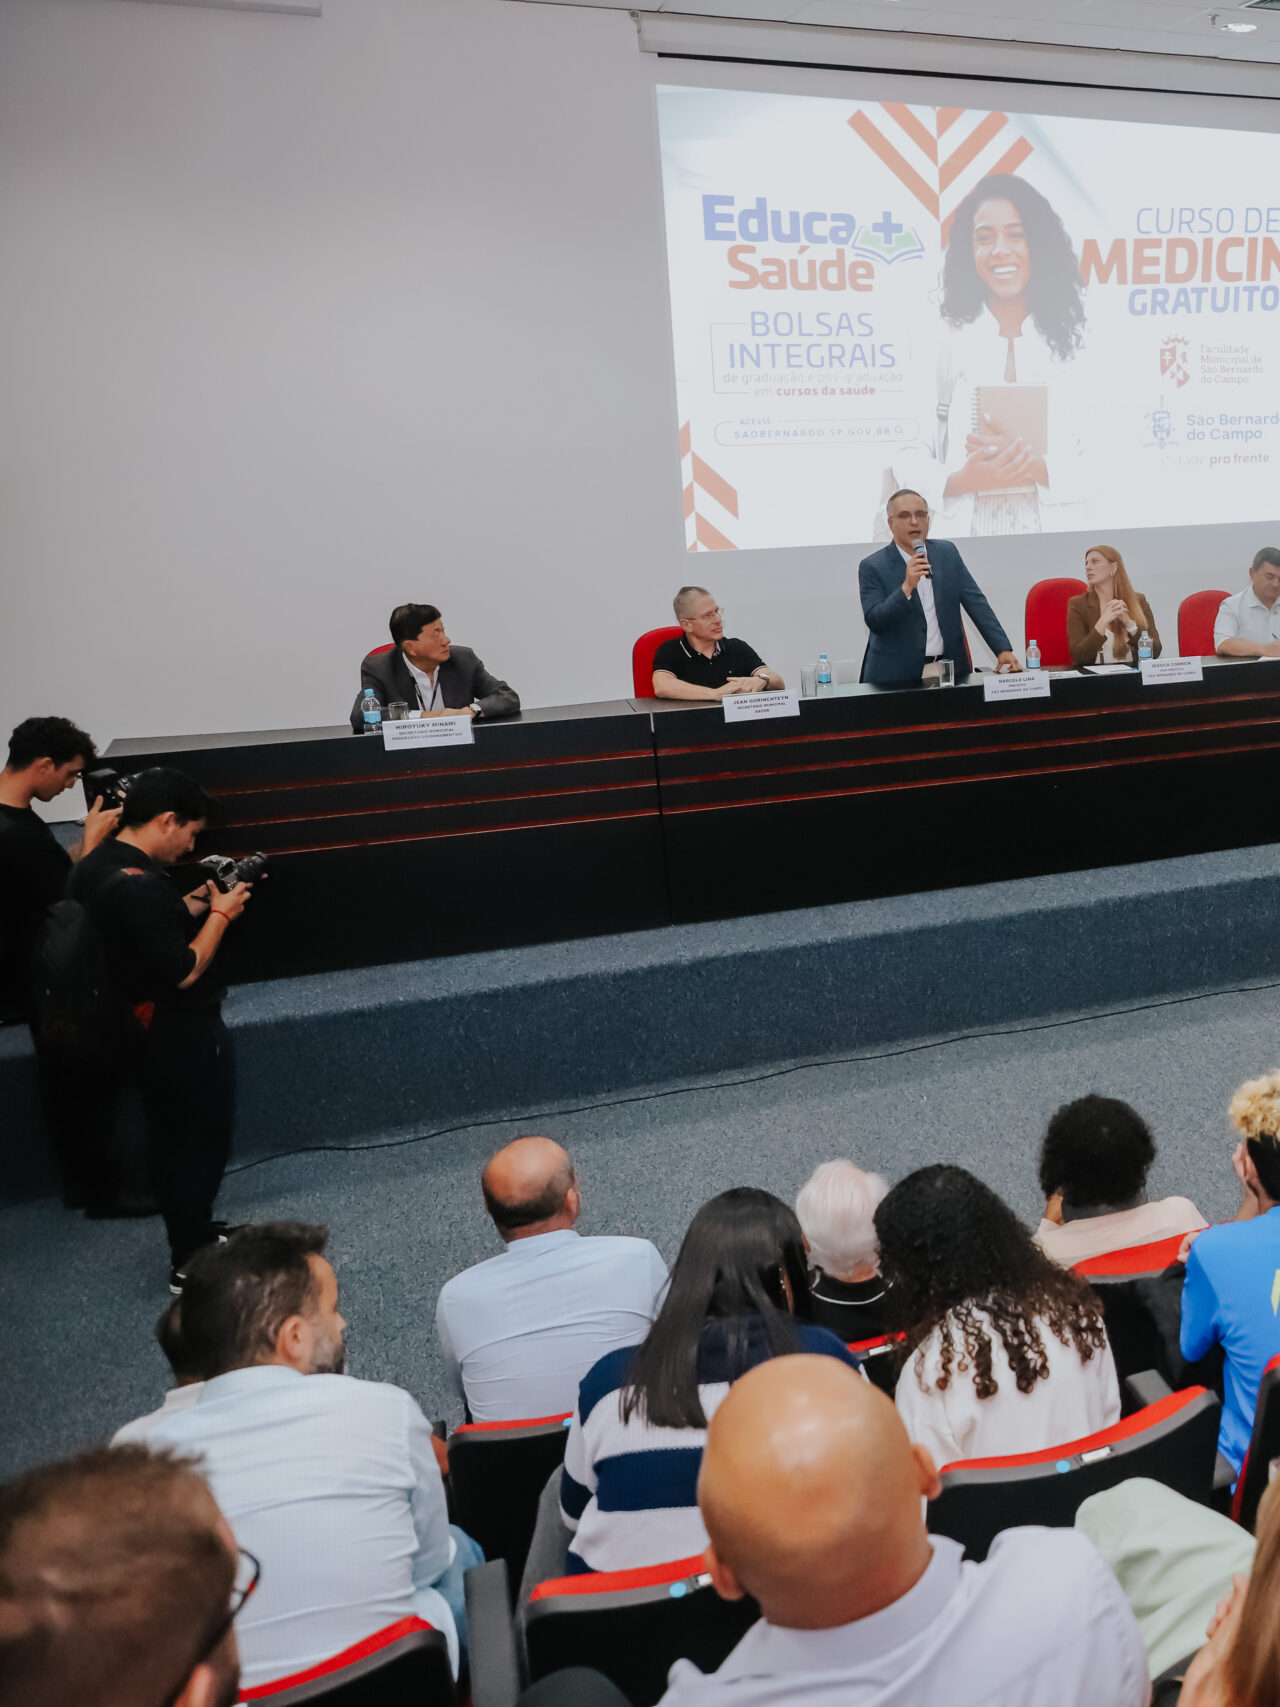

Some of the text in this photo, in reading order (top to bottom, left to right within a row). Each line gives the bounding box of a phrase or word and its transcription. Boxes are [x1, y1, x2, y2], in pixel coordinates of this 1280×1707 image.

[1136, 207, 1280, 234] CURSO DE
[727, 245, 874, 292] Saúde
[1128, 285, 1280, 316] GRATUITO
[750, 311, 873, 337] BOLSAS
[1200, 344, 1250, 353] Faculdade
[729, 343, 896, 369] INTEGRAIS
[1200, 355, 1262, 364] Municipal de
[1220, 365, 1263, 373] Bernardo
[723, 373, 737, 383] de
[1200, 375, 1250, 385] do Campo
[754, 388, 772, 396] em
[776, 387, 818, 396] cursos
[821, 386, 836, 396] da
[1186, 412, 1215, 426] São
[1186, 428, 1263, 443] do Campo
[1210, 454, 1231, 467] pra
[1233, 452, 1270, 464] frente
